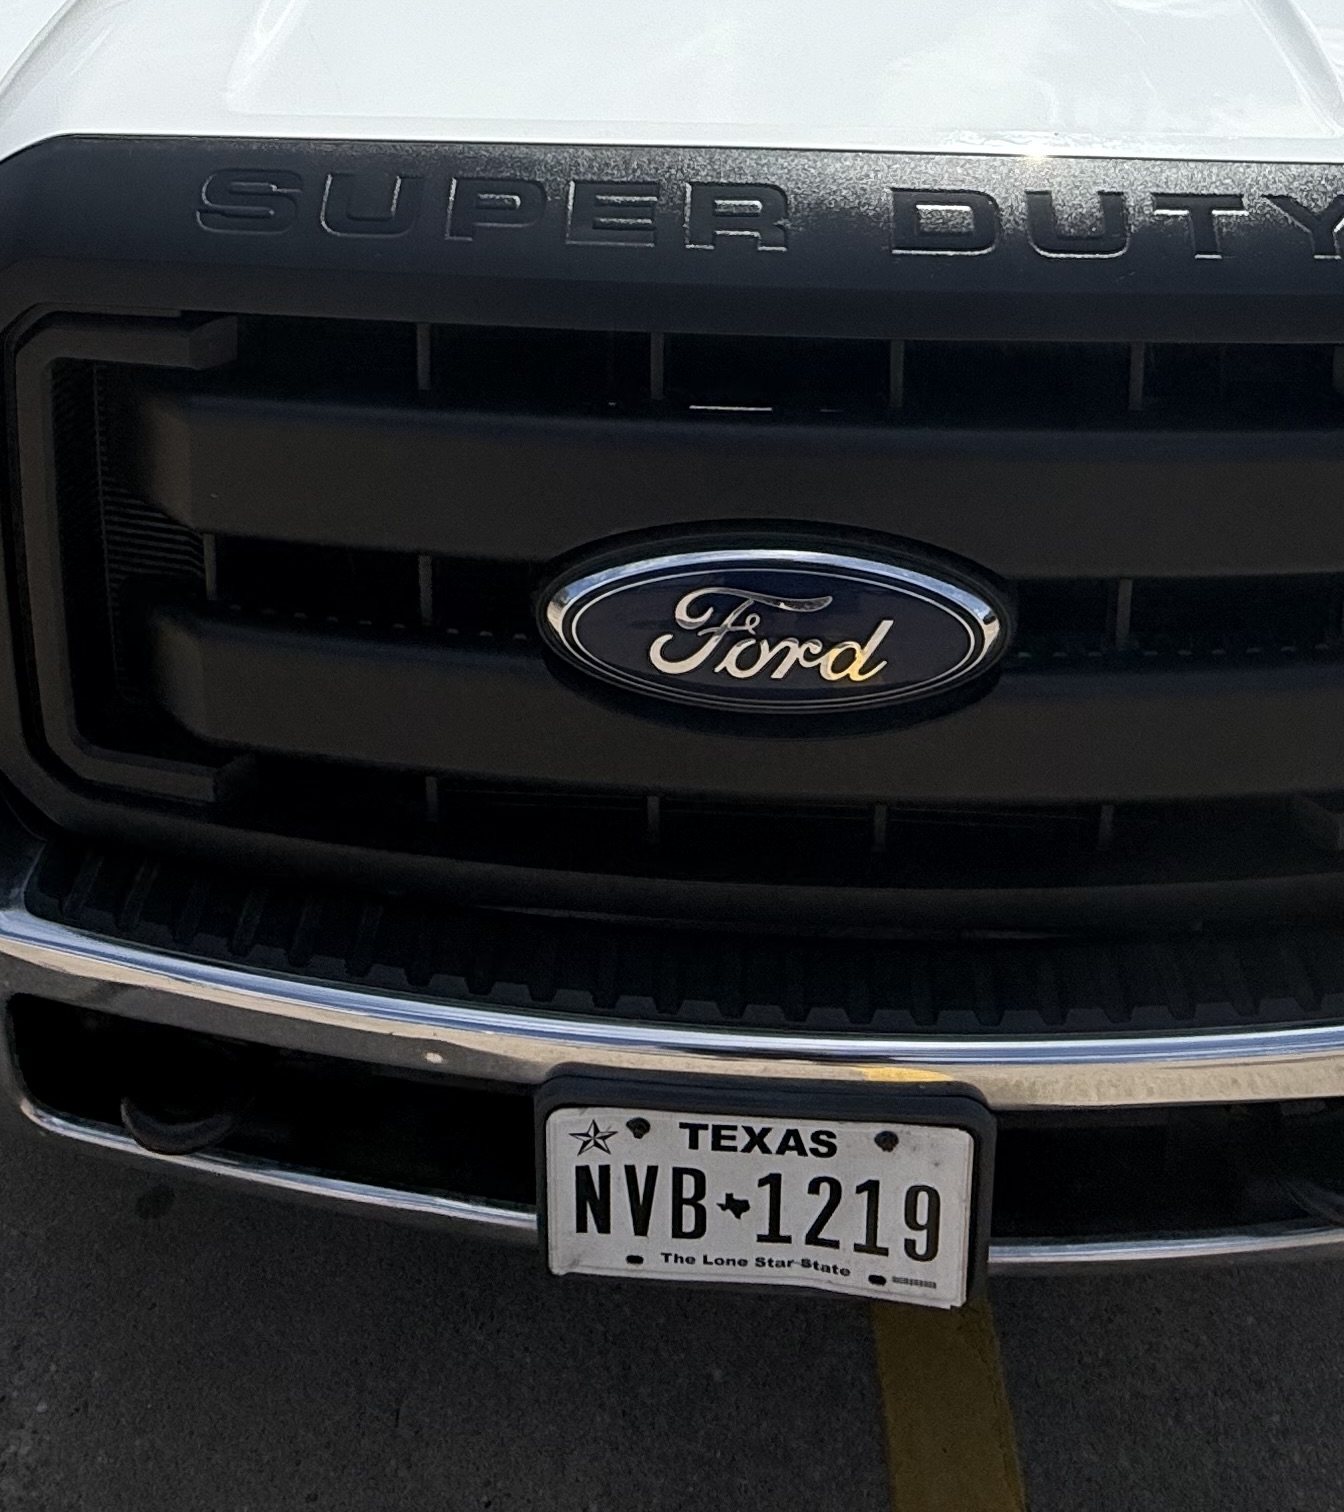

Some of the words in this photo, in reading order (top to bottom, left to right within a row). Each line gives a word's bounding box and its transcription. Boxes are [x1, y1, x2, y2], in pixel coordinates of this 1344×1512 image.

[195, 167, 789, 253] SUPER
[649, 586, 894, 682] Ford
[679, 1122, 838, 1159] TEXAS
[661, 1252, 697, 1266] The
[702, 1254, 750, 1269] Lone
[754, 1256, 795, 1270] Star
[800, 1257, 851, 1278] State
